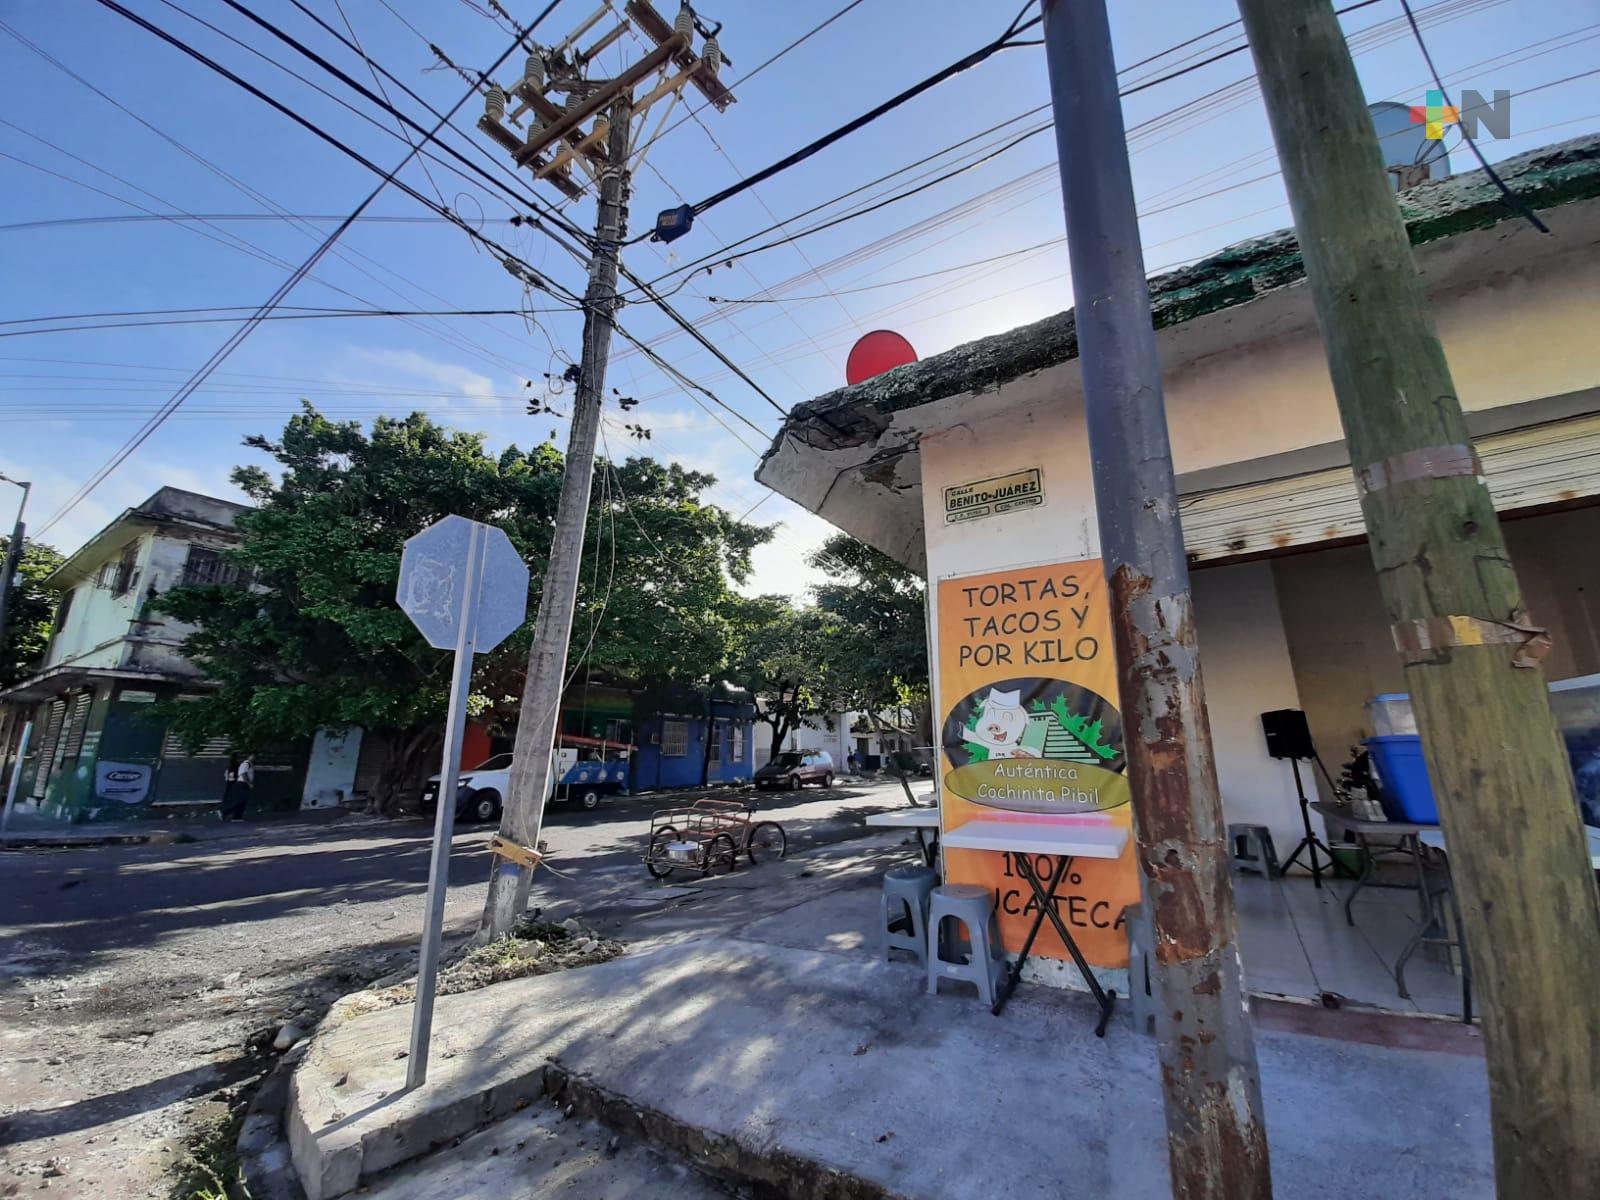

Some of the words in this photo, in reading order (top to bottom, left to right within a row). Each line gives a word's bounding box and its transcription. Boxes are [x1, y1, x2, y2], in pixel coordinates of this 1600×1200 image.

[951, 488, 974, 497] CALLE
[962, 575, 1089, 608] TORTAS,
[963, 610, 1062, 638] TACOS
[1071, 605, 1090, 630] Y
[959, 643, 1013, 668] POR
[1023, 636, 1099, 665] KILO
[994, 761, 1079, 781] Auténtica
[977, 783, 1056, 803] Cochinita
[1061, 786, 1100, 805] Pibil
